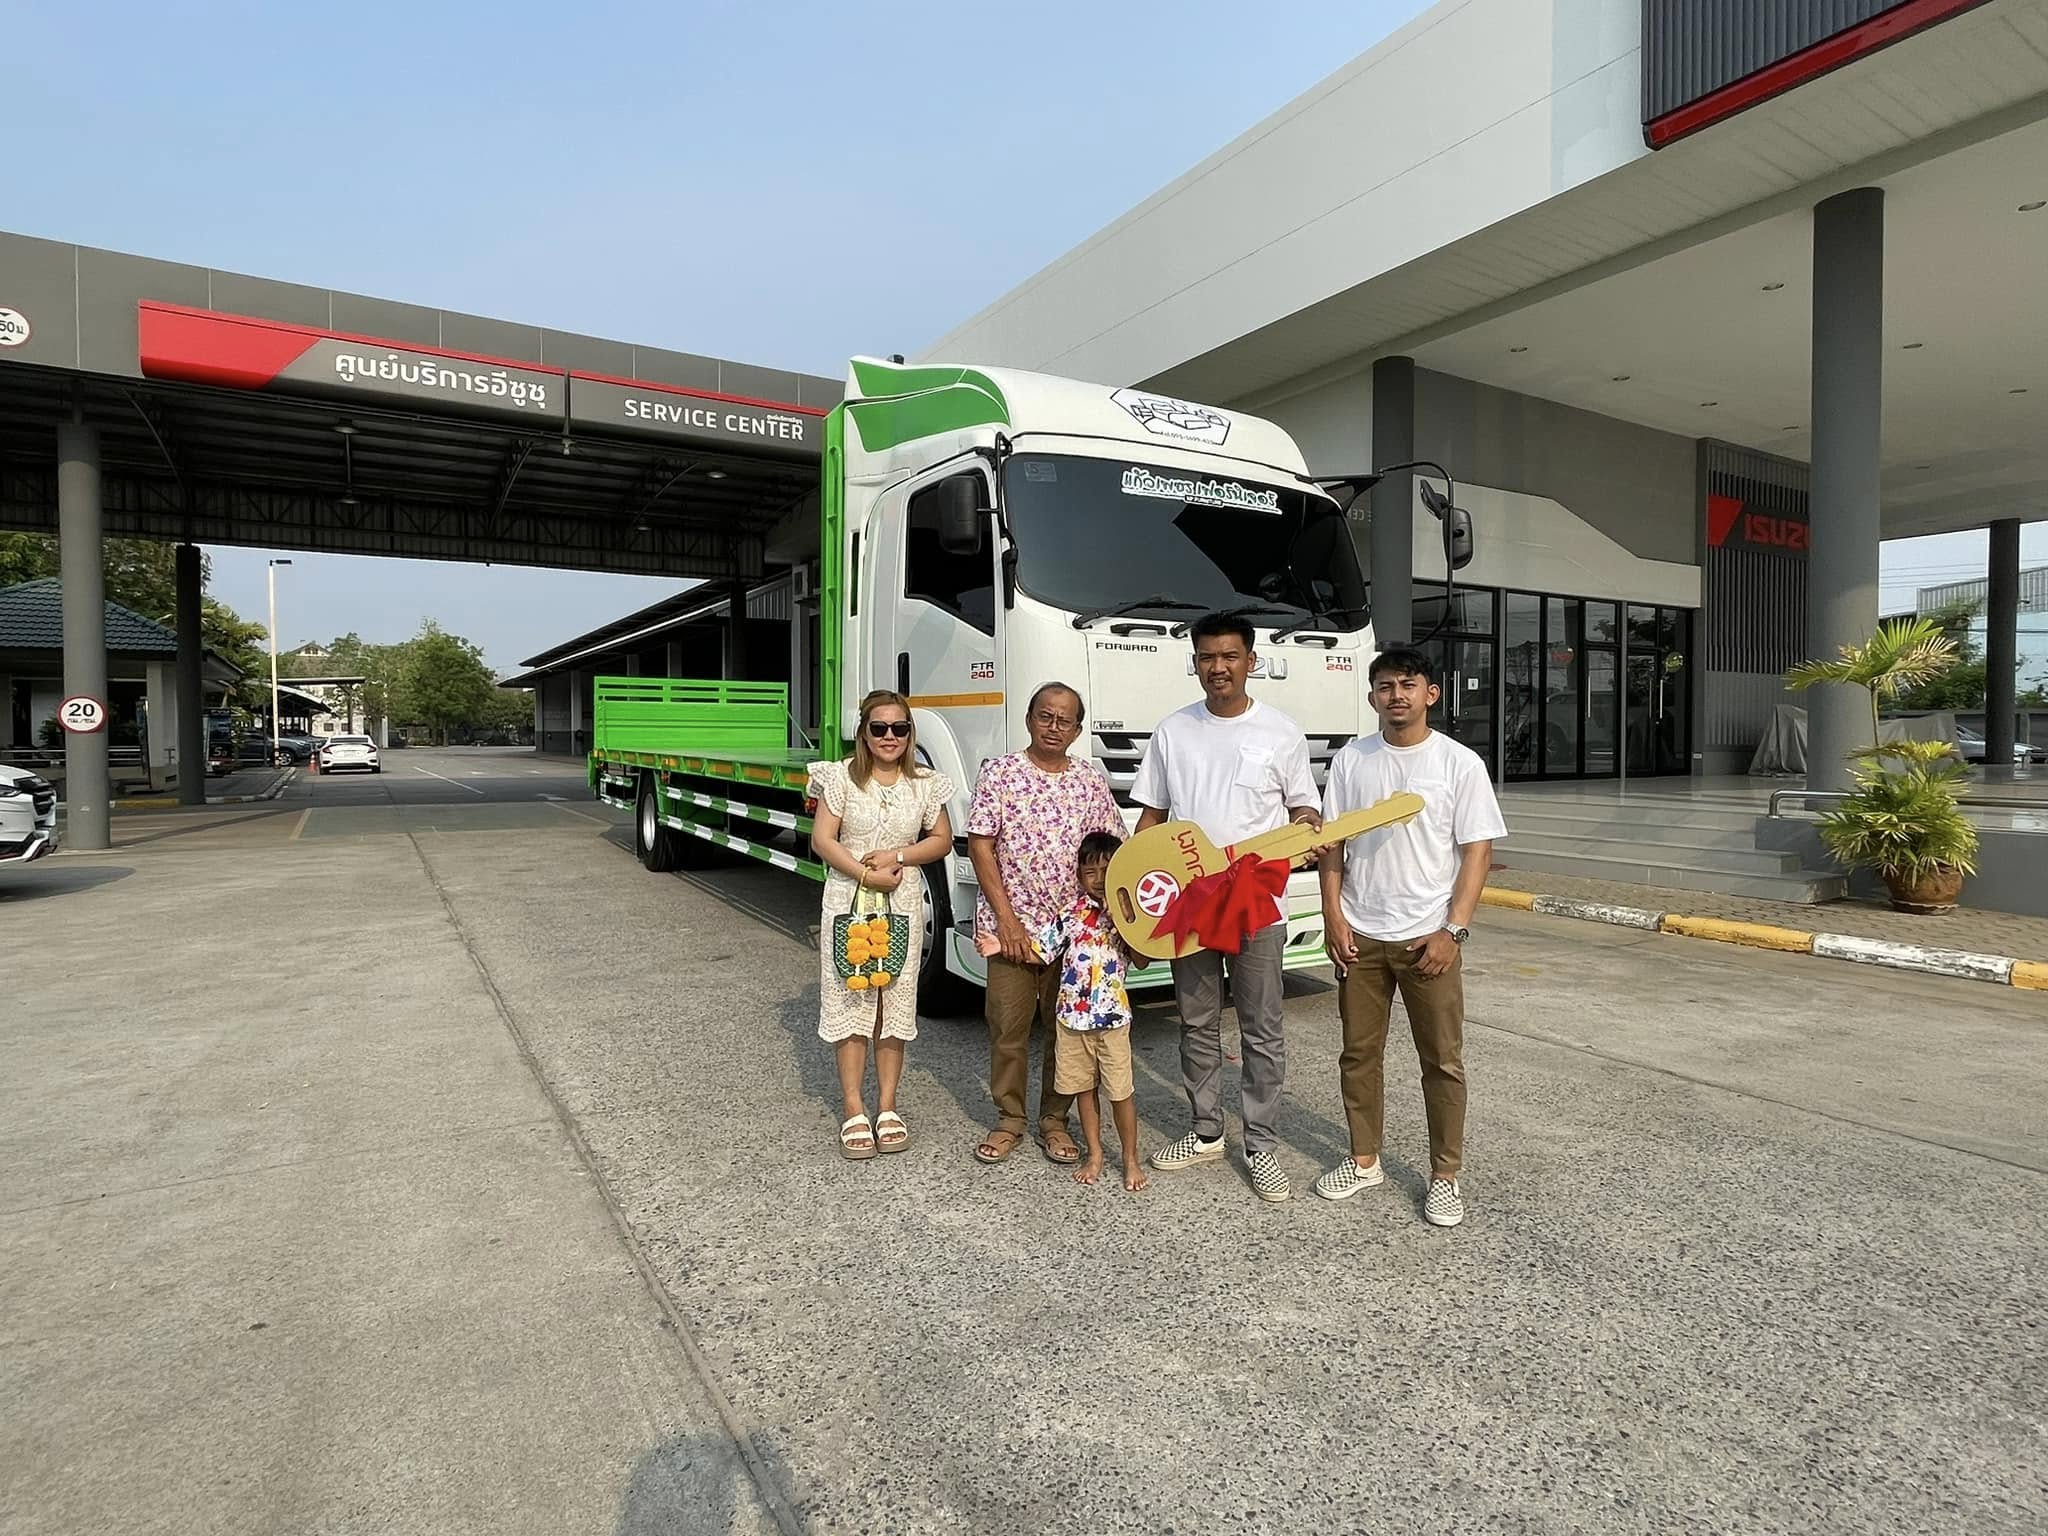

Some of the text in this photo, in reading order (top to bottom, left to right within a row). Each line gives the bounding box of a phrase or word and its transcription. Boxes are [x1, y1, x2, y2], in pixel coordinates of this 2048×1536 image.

[335, 354, 546, 409] ศูนย์บริการอีซูซุ
[624, 399, 804, 441] SERVICE CENTER
[1744, 512, 1809, 552] ISUZ
[1095, 642, 1158, 653] FORWARD
[1326, 655, 1352, 664] FTR
[970, 662, 994, 671] FTR
[1186, 652, 1288, 680] IZU
[1326, 664, 1353, 672] 240
[970, 671, 995, 680] 240
[69, 703, 95, 717] 20
